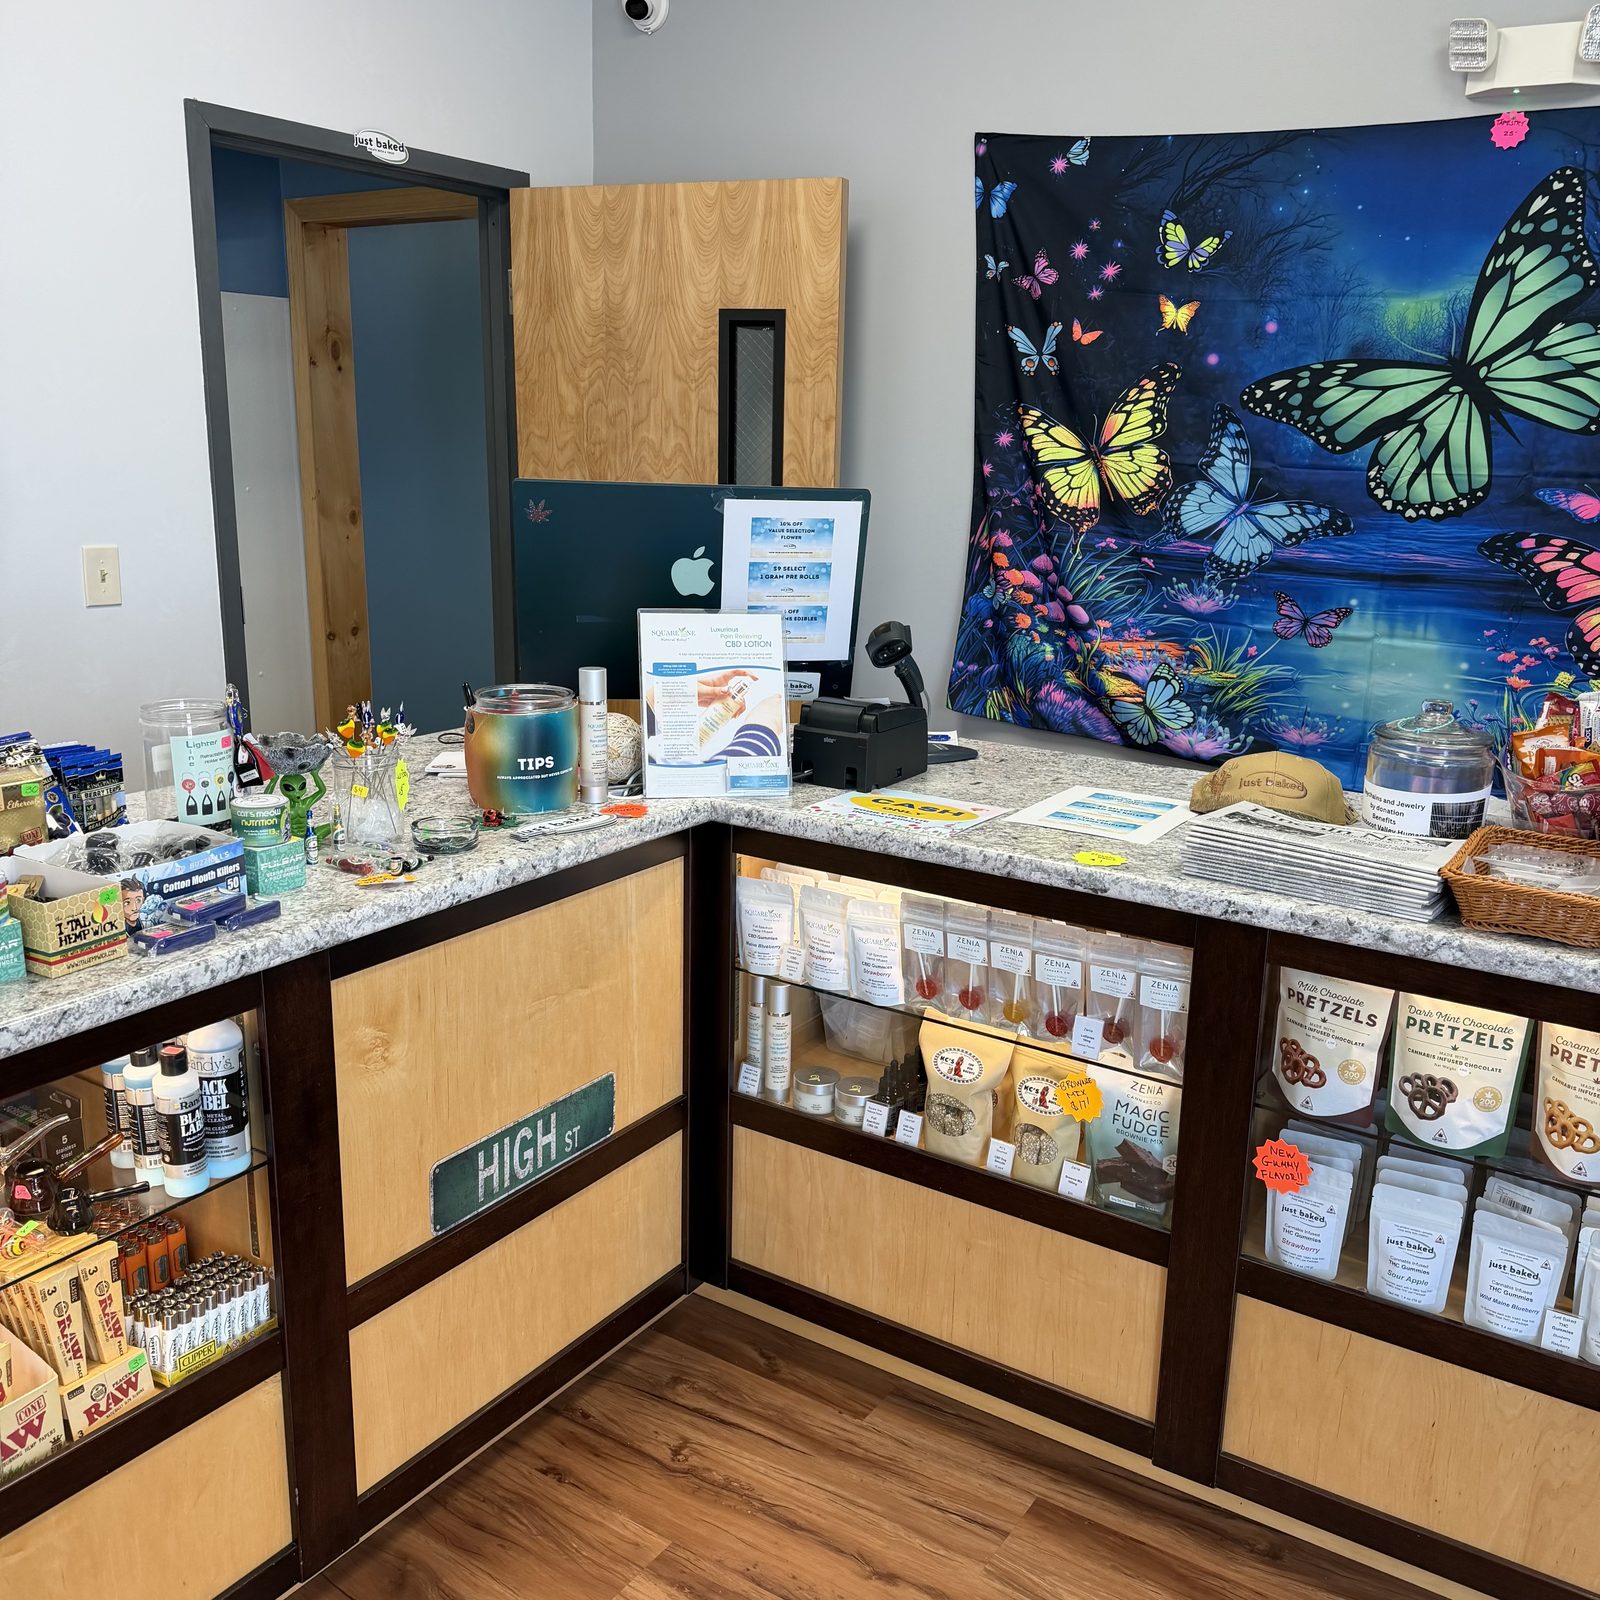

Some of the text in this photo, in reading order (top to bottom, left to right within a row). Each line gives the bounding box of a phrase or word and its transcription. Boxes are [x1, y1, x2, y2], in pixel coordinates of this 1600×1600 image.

[354, 134, 373, 146] just
[375, 137, 405, 153] baked
[725, 640, 772, 648] CBD LOTION
[185, 740, 217, 749] Lighter
[517, 756, 555, 771] TIPS
[84, 785, 122, 799] BERRY TERPS
[1238, 776, 1305, 792] just baked
[871, 798, 965, 817] CASH
[882, 806, 923, 816] ONLY
[1370, 803, 1405, 817] by donation
[1382, 798, 1426, 812] and Jewelry
[1372, 813, 1397, 826] Benefits
[162, 862, 240, 894] Cotton Mouth Killers
[226, 876, 239, 890] 50
[55, 915, 91, 936] I-TAL
[58, 919, 118, 948] HEMP WICK
[912, 928, 936, 938] ZENIA
[956, 936, 980, 948] ZENIA
[1000, 945, 1024, 958] ZENIA
[1044, 958, 1070, 970] ZENIA
[863, 968, 891, 978] Strawberry
[1100, 969, 1127, 981] ZENIA
[1151, 980, 1179, 992] ZENIA
[1297, 980, 1365, 1008] Milk Chocolate
[1287, 987, 1378, 1028] PRETZELS
[1309, 1021, 1336, 1033] MADE WITH
[1407, 1004, 1514, 1035] Dark Mint Chocolate
[1286, 1017, 1365, 1048] CANNABIS INFUSED CHOCOLATE
[1405, 1015, 1515, 1052] PRETZELS
[1555, 1035, 1600, 1056] Caramel
[939, 1055, 956, 1066] KC'S
[1407, 1047, 1502, 1074] CANNABIS INFUSED CHOCOLATE
[1550, 1043, 1600, 1073] PRET
[1344, 1070, 1360, 1079] 200
[201, 1078, 229, 1096] ACK
[1023, 1084, 1040, 1094] KC'S
[1059, 1077, 1093, 1092] BROWNIE
[1130, 1080, 1164, 1096] ZENIA
[1551, 1075, 1600, 1099] CANNABIS INFUSE
[1066, 1090, 1087, 1099] MIX
[1479, 1098, 1496, 1106] 200
[201, 1094, 230, 1112] BEL
[1115, 1099, 1170, 1123] MAGIC
[1112, 1113, 1170, 1139] FUDGE
[61, 1134, 68, 1144] 5
[1115, 1128, 1164, 1146] BROWNIE MIX
[55, 1143, 77, 1156] Stainless
[61, 1151, 73, 1160] Steel
[478, 1111, 581, 1203] HIGH ST
[1269, 1146, 1296, 1159] NEW
[1281, 1204, 1325, 1223] just baked
[1282, 1228, 1322, 1244] THC Gummies
[1284, 1223, 1321, 1237] Cannabis Infused
[1281, 1238, 1321, 1255] Strawberry
[1386, 1236, 1434, 1254] just baked
[111, 1259, 120, 1281] CLASSIC
[1388, 1259, 1430, 1276] THC Gummies
[1389, 1255, 1429, 1269] Cannabis Infused
[1488, 1260, 1540, 1280] just baked
[88, 1265, 99, 1276] 3
[1387, 1269, 1429, 1287] Sour Apple
[46, 1285, 57, 1297] 3
[70, 1279, 79, 1302] CLASSIC
[1489, 1285, 1534, 1303] THC Gummies
[1491, 1279, 1533, 1295] Cannabis Infused
[1479, 1293, 1541, 1316] Wild Maine Blueberry
[98, 1292, 125, 1339] RAW
[56, 1313, 84, 1361] RAW
[1551, 1326, 1574, 1335] Gummies
[181, 1344, 214, 1368] CLIPPER
[82, 1370, 140, 1427] RAW
[17, 1398, 44, 1422] CONE
[0, 1410, 46, 1462] AW
[38, 1428, 56, 1443] PAPERS
[77, 1429, 85, 1439] 3
